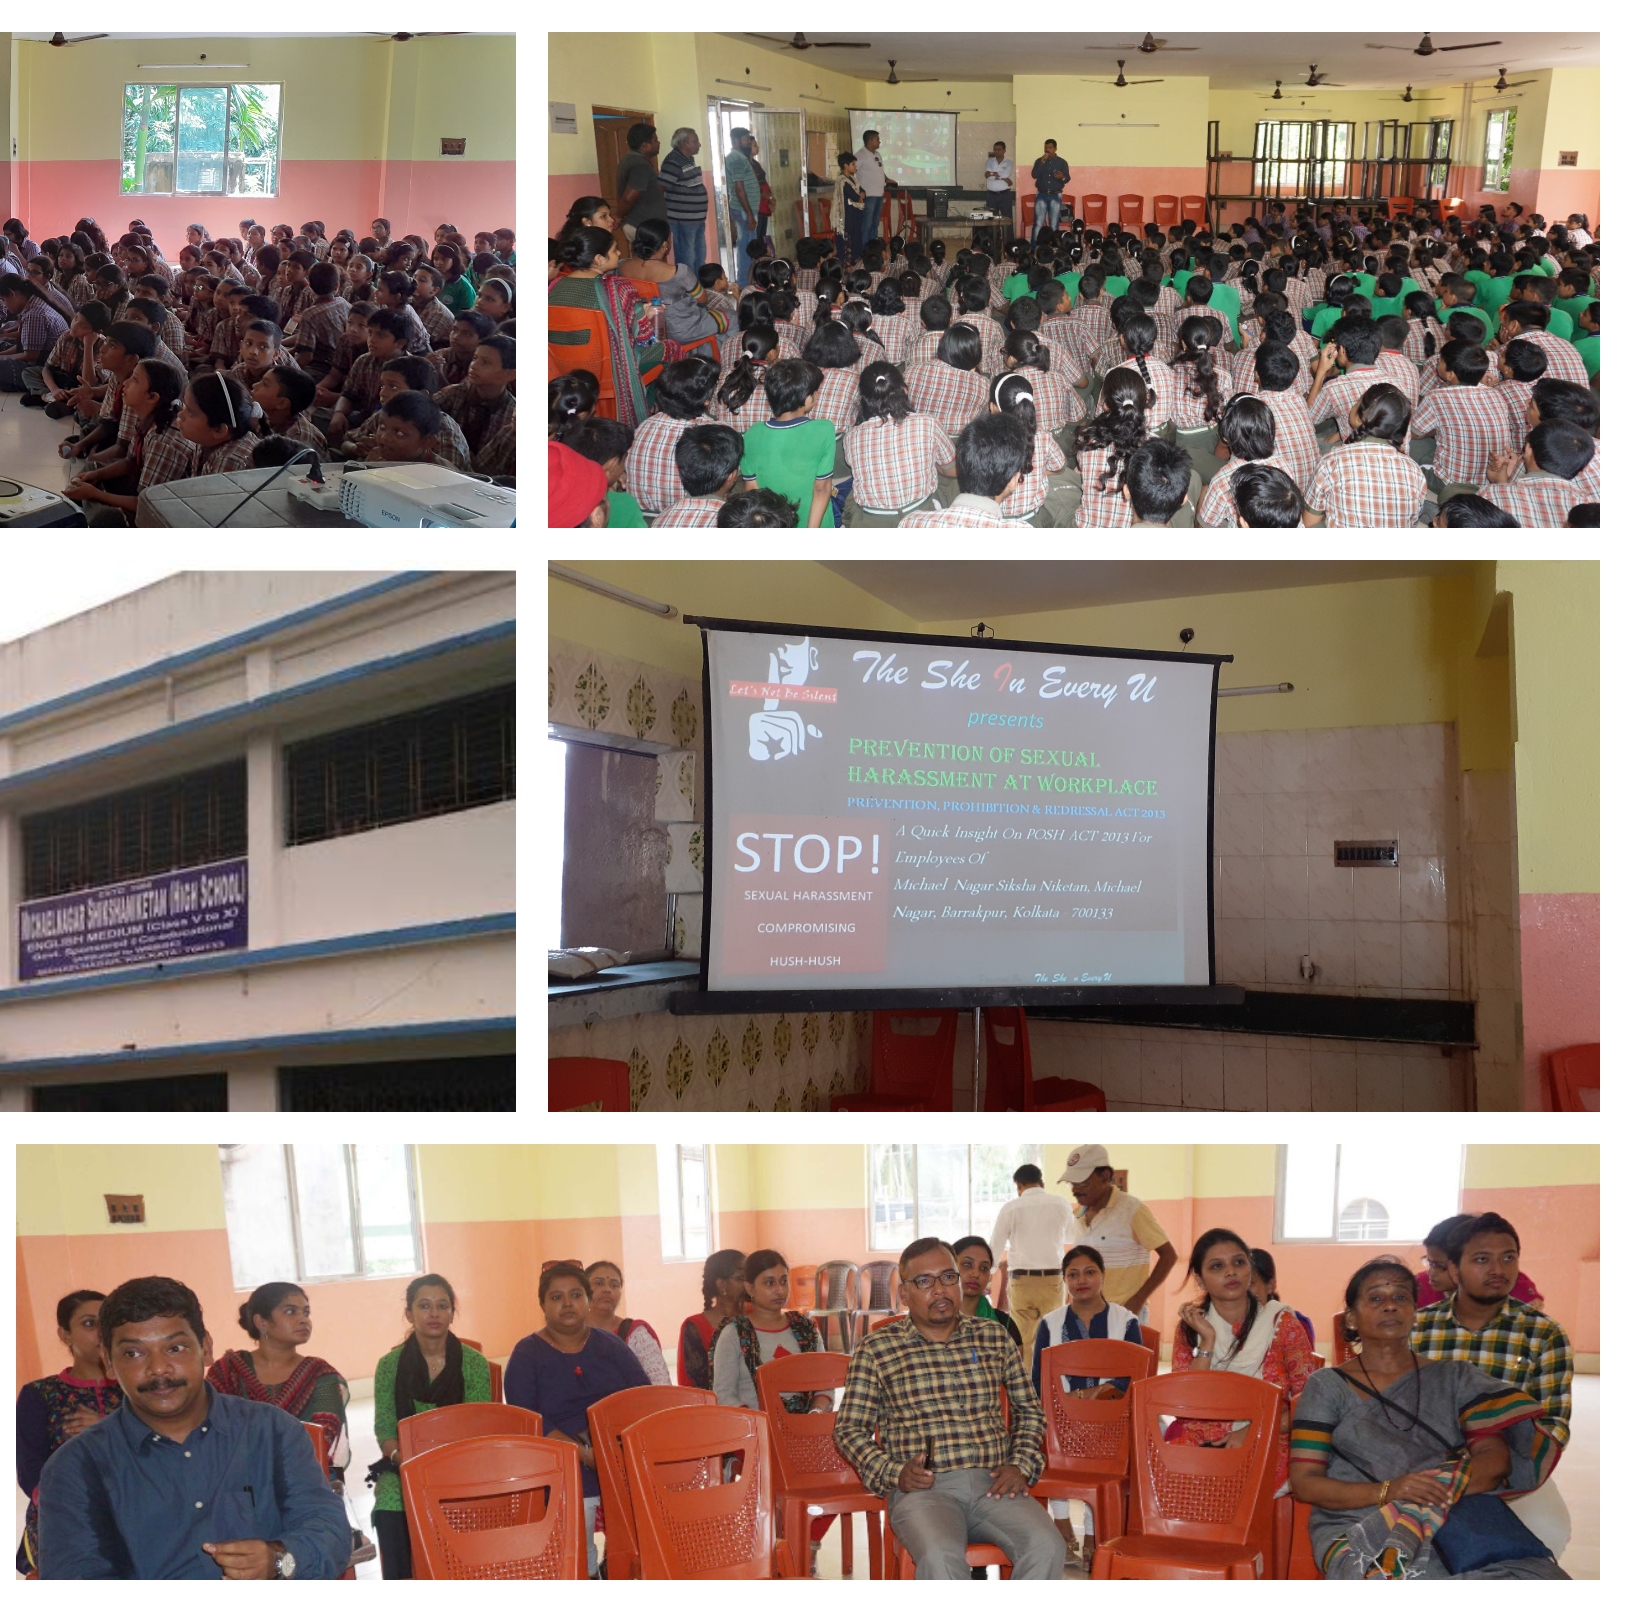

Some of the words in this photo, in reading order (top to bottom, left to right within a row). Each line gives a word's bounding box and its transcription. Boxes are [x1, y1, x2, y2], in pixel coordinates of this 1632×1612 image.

[381, 510, 400, 522] EPSON
[852, 650, 909, 685] The
[920, 659, 982, 690] She
[993, 663, 1026, 694] In
[1038, 665, 1118, 708] Every
[1126, 673, 1158, 703] U
[729, 684, 757, 695] Let's
[761, 686, 781, 697] Not
[784, 687, 799, 698] Be
[801, 689, 838, 702] Silent
[967, 710, 1045, 729] presents
[848, 738, 984, 763] PREVENTION
[988, 746, 1016, 764] OF
[1020, 748, 1102, 769] SEXUAL
[847, 765, 998, 790] HARASSMENT
[1003, 773, 1032, 791] AT
[1037, 773, 1159, 796] WORKPLACE
[847, 797, 940, 813] PREVENTION,
[943, 801, 1030, 815] PROHIBITION
[1031, 804, 1041, 815] &
[1044, 804, 1112, 818] REDRESSAL
[1114, 807, 1141, 818] ACT
[1141, 809, 1166, 820] 2013
[895, 825, 906, 838] A
[910, 825, 949, 840] Quick
[954, 826, 998, 843] Insight
[1002, 828, 1022, 840] On
[1026, 829, 1065, 841] POSH
[1068, 829, 1099, 842] ACT
[1100, 831, 1129, 844] 2013
[1131, 831, 1153, 843] For
[734, 832, 880, 875] STOP!
[894, 851, 966, 868] Employees
[968, 851, 989, 865] Of
[744, 890, 789, 901] SEXUAL
[793, 891, 873, 901] HARASSMENT
[893, 878, 949, 892] Michael
[953, 879, 994, 896] Nagar
[996, 879, 1036, 892] Siksha
[1039, 880, 1091, 894] Niketan,
[1093, 880, 1142, 893] Michael
[892, 905, 937, 921] Nagar,
[941, 905, 1008, 922] Barrakpur,
[1012, 905, 1060, 918] Kolkata
[1071, 908, 1114, 920] 700133
[27, 934, 83, 952] ENGLISH
[86, 925, 143, 942] MEDIUM
[191, 914, 201, 924] V
[205, 913, 219, 922] to
[757, 923, 856, 933] COMPROMISING
[770, 956, 841, 966] HUSH-HUSH
[1034, 973, 1048, 983] The
[1052, 973, 1067, 983] She
[1081, 973, 1102, 983] Every
